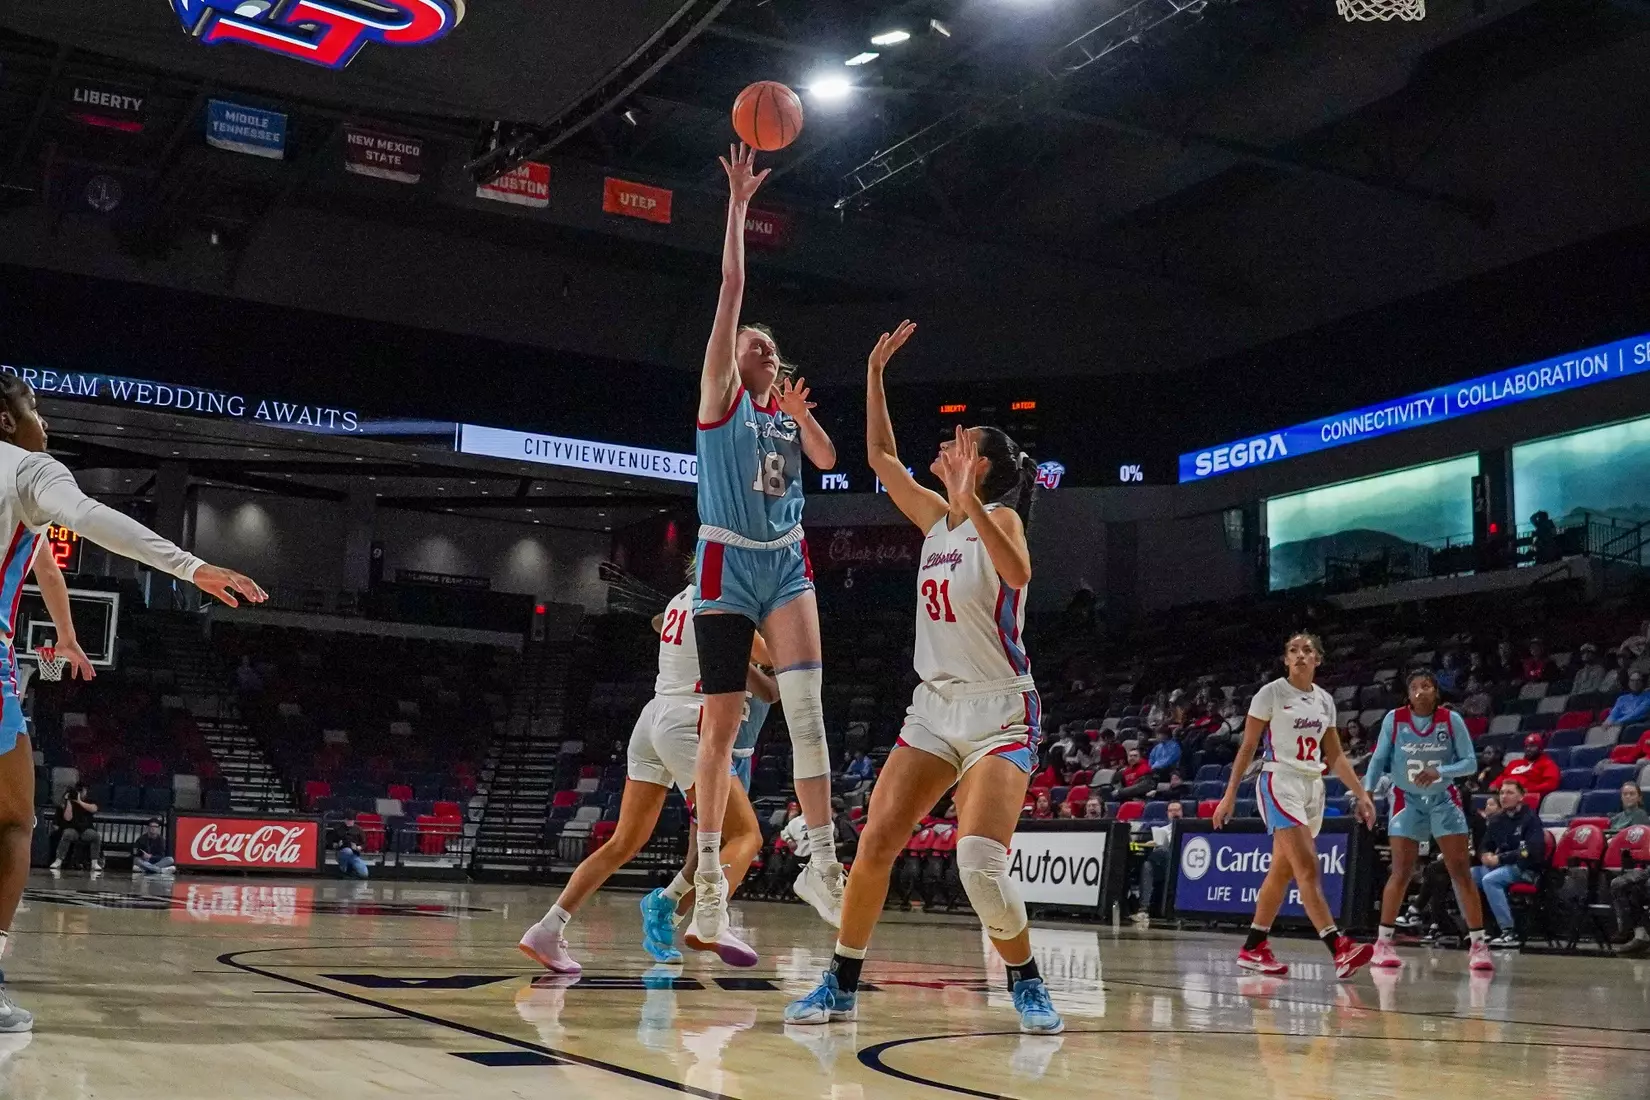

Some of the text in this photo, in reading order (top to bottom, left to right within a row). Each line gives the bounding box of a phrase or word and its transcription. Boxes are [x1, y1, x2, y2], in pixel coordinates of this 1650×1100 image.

[73, 88, 143, 111] LIBERTY
[224, 110, 269, 128] MIDDLE
[212, 121, 280, 143] TENNESSEE
[347, 134, 420, 157] NEW MEXICO
[365, 150, 402, 165] STATE
[490, 176, 548, 196] USTON
[619, 191, 657, 210] UTEP
[744, 218, 773, 234] WKU
[109, 379, 245, 417] WEDDING
[254, 400, 365, 432] AWAITS.
[940, 404, 967, 413] LIBERTY
[1195, 432, 1288, 476] SEGRA
[1321, 397, 1435, 442] CONNECTIVITY
[1457, 353, 1609, 408] COLLABORATION
[753, 449, 787, 497] 18
[822, 473, 849, 490] FT%
[1120, 464, 1144, 482] 0%
[922, 549, 963, 571] Liberty
[921, 579, 957, 622] 31
[660, 608, 688, 646] 21
[1293, 718, 1323, 733] Liberty
[1296, 735, 1318, 761] 12
[190, 823, 305, 863] Coca-Cola
[1008, 849, 1100, 886] Autova
[1216, 846, 1272, 873] Carte
[1207, 886, 1233, 901] LIFE
[1241, 888, 1261, 903] LIV
